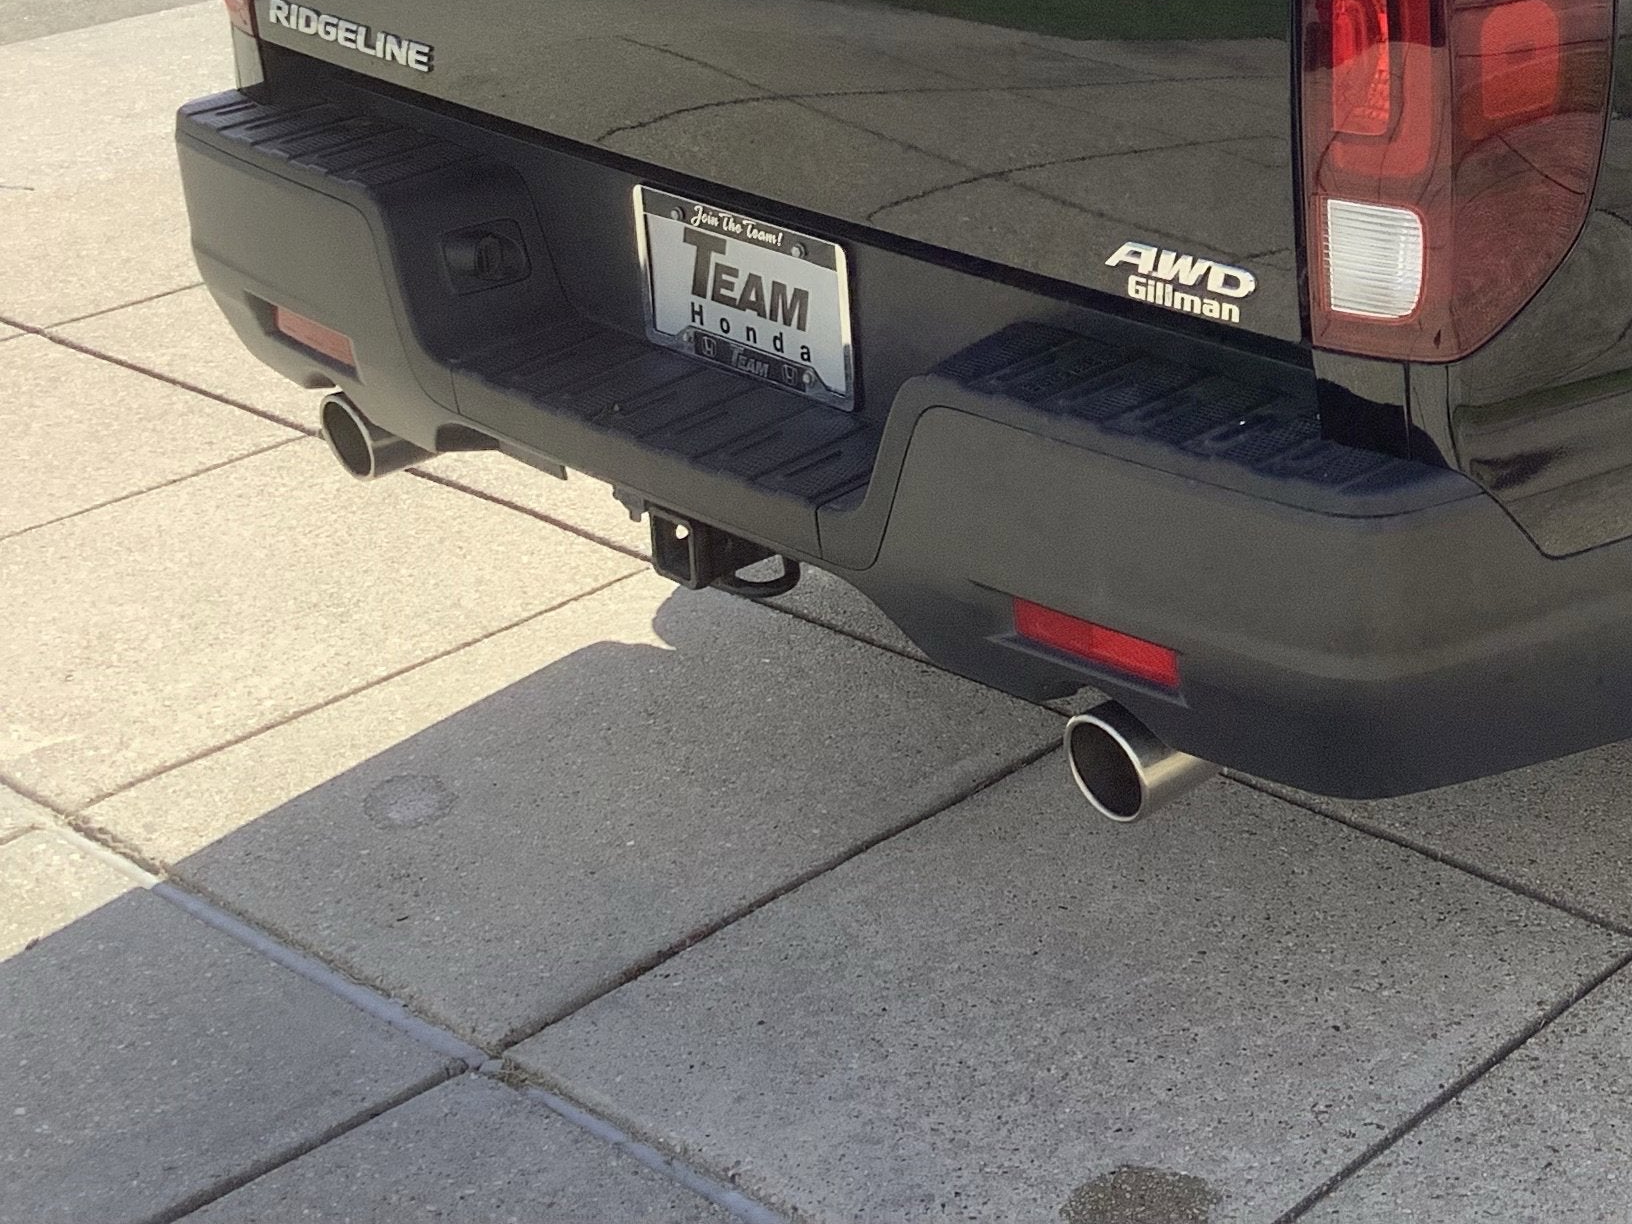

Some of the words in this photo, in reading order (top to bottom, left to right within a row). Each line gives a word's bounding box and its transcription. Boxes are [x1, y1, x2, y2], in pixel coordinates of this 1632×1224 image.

[690, 205, 719, 227] Join
[718, 212, 744, 234] The
[742, 219, 783, 247] Team!
[683, 226, 809, 332] TEAM
[1104, 241, 1257, 298] AWD
[1127, 274, 1240, 323] Gillman
[690, 301, 812, 364] Honda
